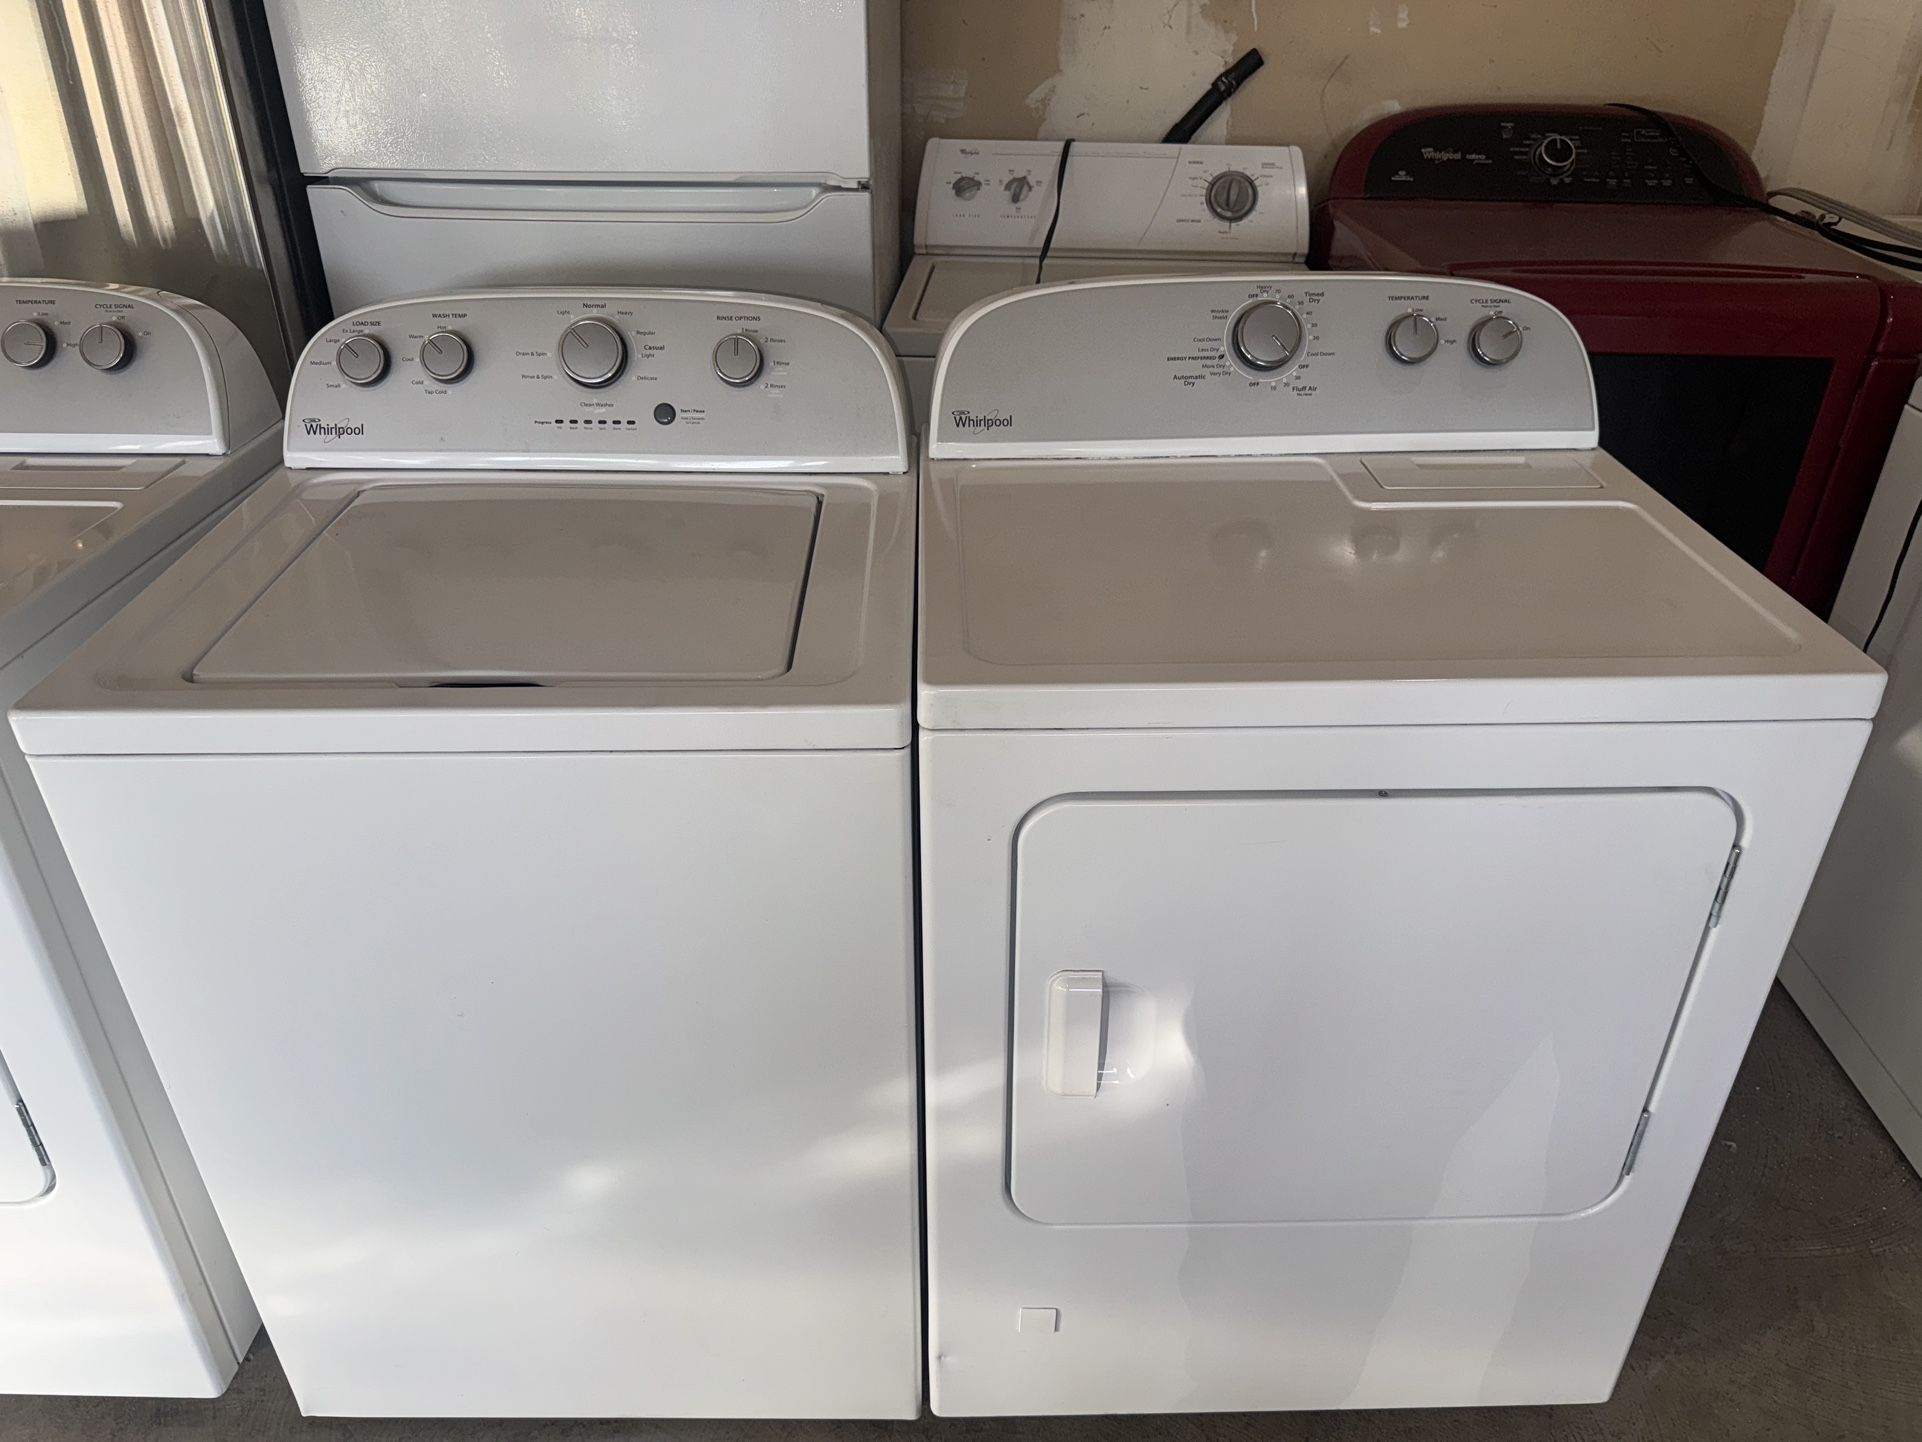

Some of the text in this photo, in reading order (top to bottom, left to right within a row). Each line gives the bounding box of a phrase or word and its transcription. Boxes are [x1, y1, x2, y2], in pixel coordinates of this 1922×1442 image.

[1423, 151, 1462, 160] Whirlpool
[304, 423, 364, 439] Whirlpool
[953, 415, 1013, 431] Whirlpool
